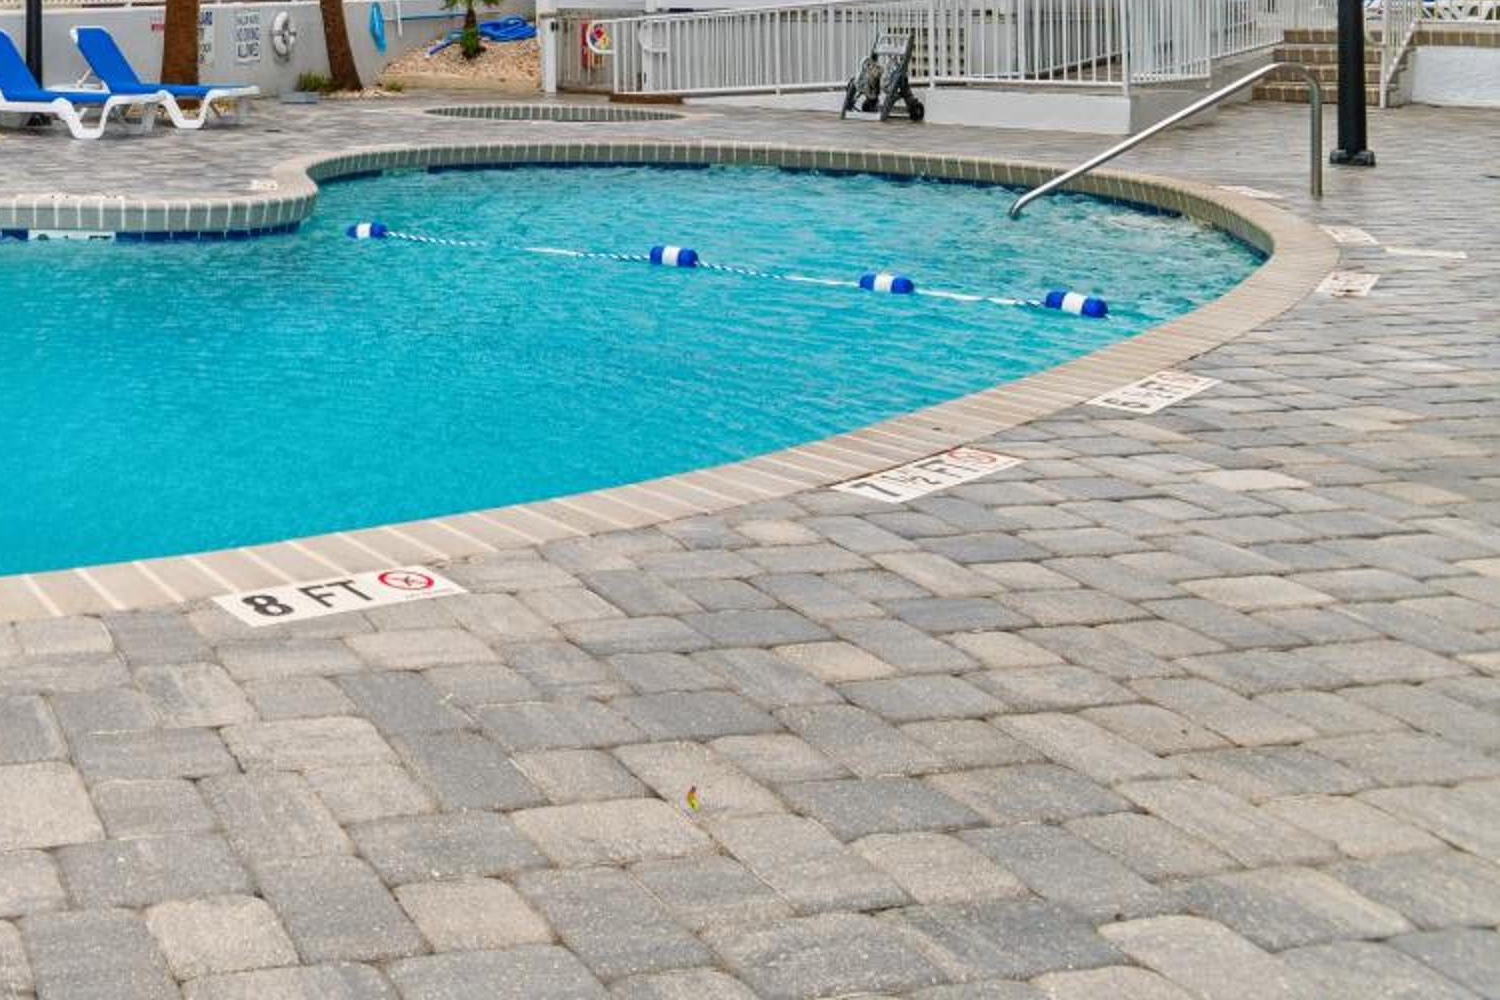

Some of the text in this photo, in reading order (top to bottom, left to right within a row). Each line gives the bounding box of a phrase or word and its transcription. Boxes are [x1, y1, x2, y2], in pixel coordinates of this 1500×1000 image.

[914, 459, 980, 478] FT
[241, 579, 373, 618] 8 FT
